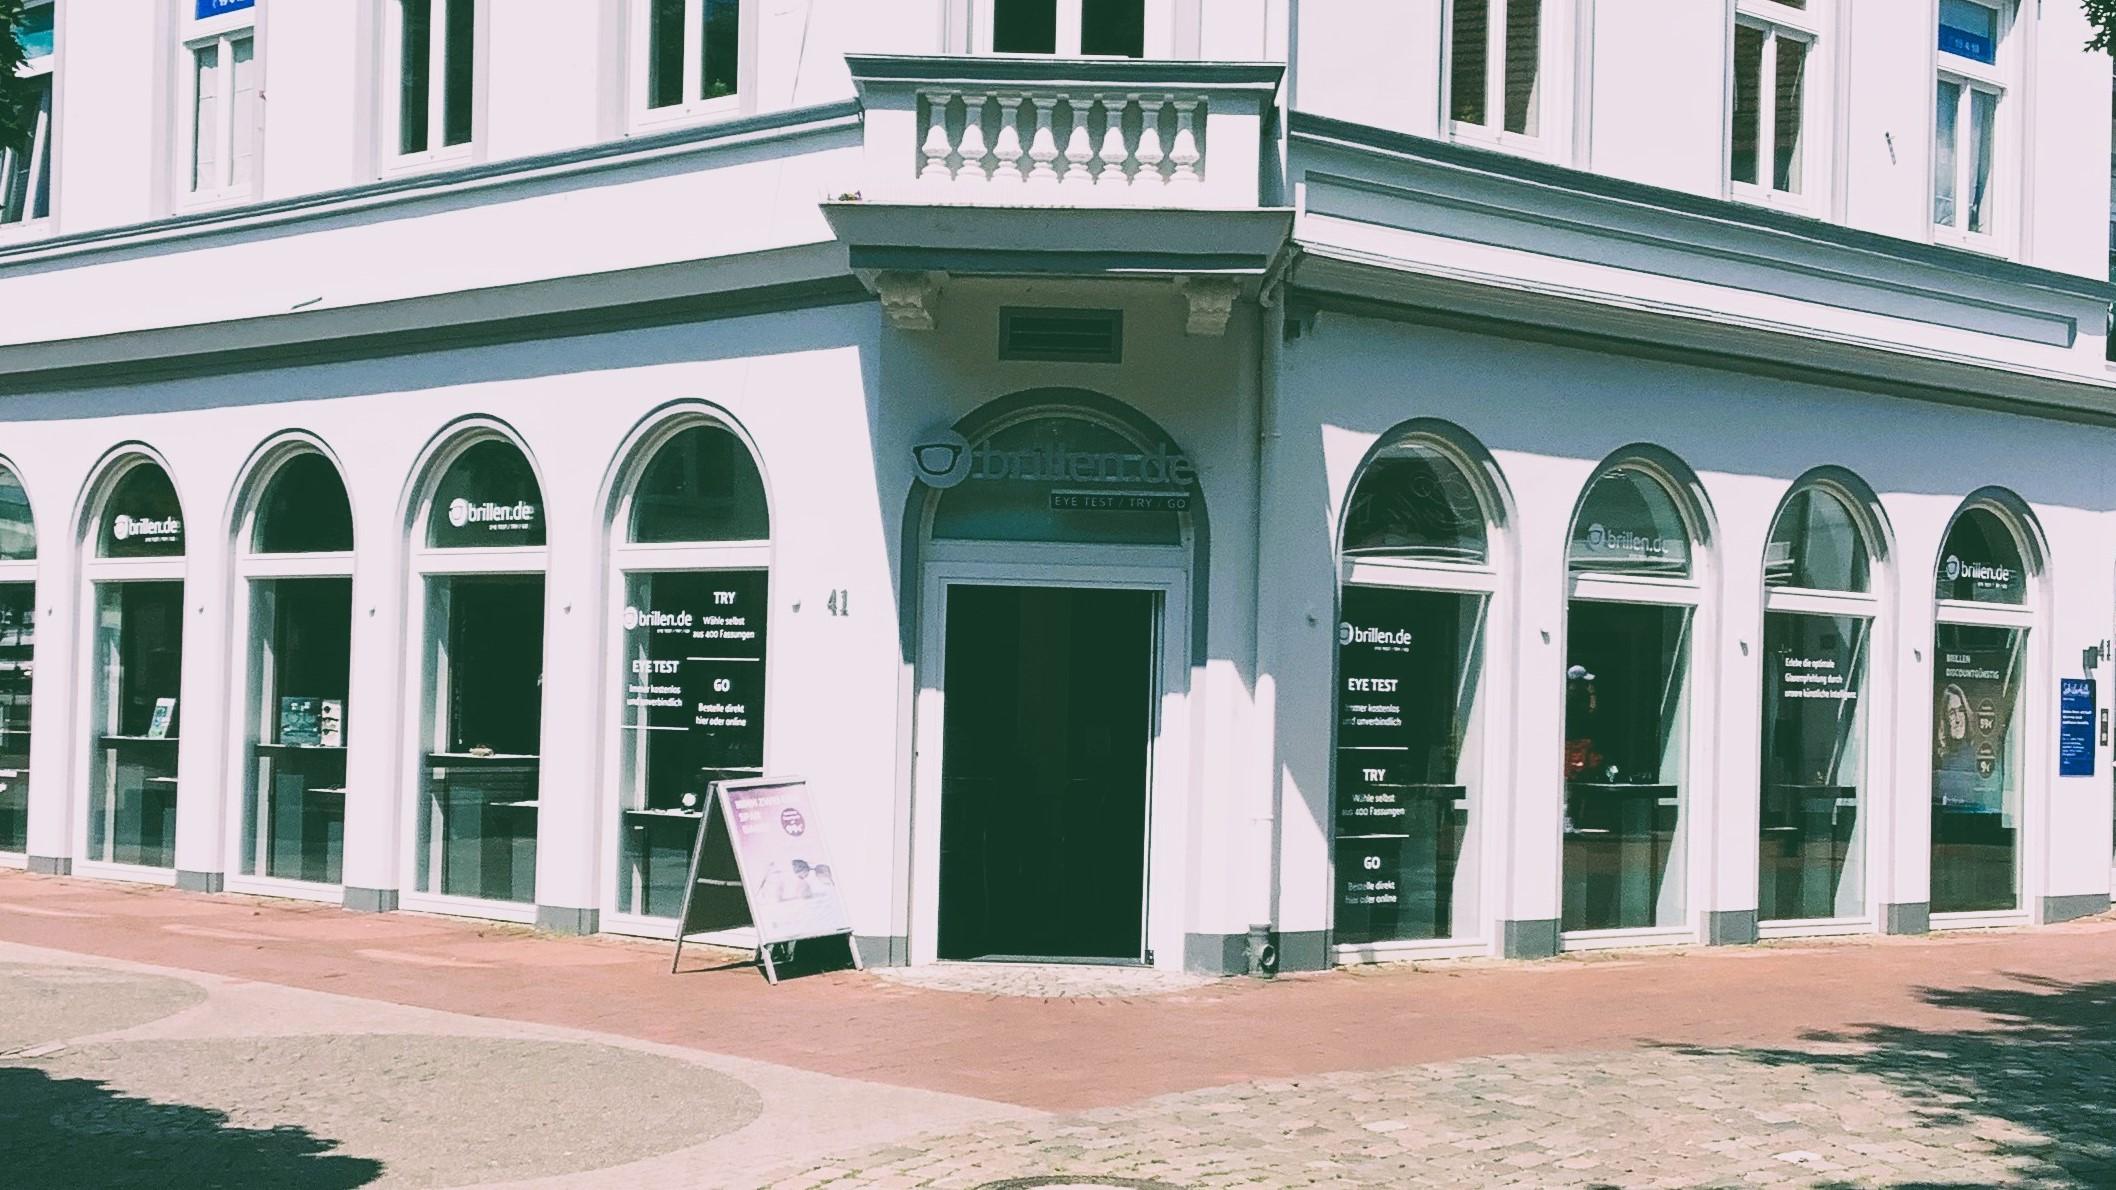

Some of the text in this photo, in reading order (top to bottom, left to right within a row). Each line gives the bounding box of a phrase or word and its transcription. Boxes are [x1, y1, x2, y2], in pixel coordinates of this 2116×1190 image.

[982, 440, 1193, 486] brillen.de
[1055, 496, 1077, 507] EYE
[1085, 497, 1113, 508] TEST
[1130, 498, 1152, 508] TRY
[1168, 499, 1186, 510] GO
[468, 501, 534, 522] brillen.de
[128, 516, 181, 536] brillen.de
[1962, 561, 2010, 581] brillen.de
[714, 591, 736, 605] TRY
[827, 588, 849, 617] 41
[639, 610, 693, 627] brillen.de
[702, 616, 745, 626] Wähle selbst
[693, 630, 705, 639] aus
[705, 630, 718, 639] 400
[719, 629, 755, 641] Fassungen
[1355, 626, 1412, 645] brillen.de
[632, 660, 680, 674] EYE TEST
[714, 678, 730, 692] GO
[1348, 678, 1398, 692] EYE TEST
[698, 703, 745, 714] Bestelle direkt
[1368, 704, 1401, 713] kostenlos
[695, 715, 747, 727] hier oder online
[1363, 768, 1386, 782] TRY
[1375, 793, 1396, 803] selbst
[1355, 808, 1368, 816] 400
[1369, 806, 1406, 818] Fassungen
[1363, 856, 1381, 870] GO
[1375, 880, 1396, 891] direkt
[1376, 894, 1398, 904] online
